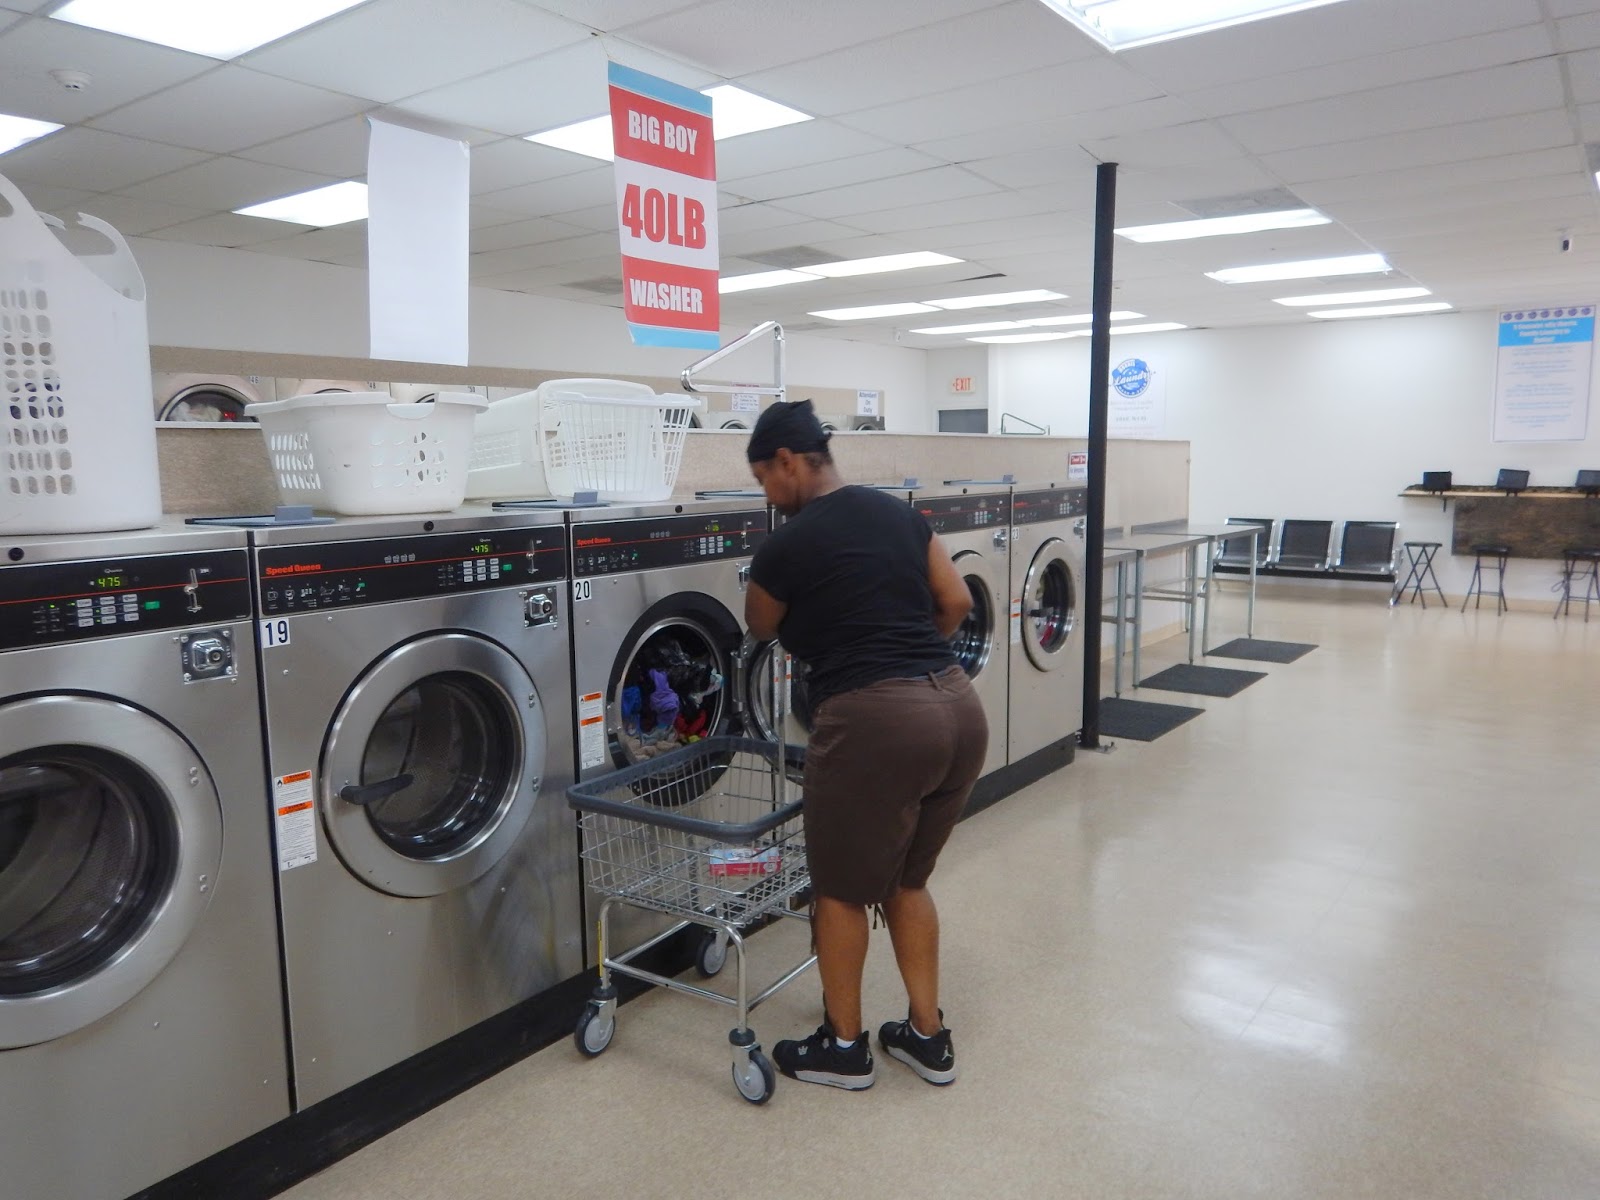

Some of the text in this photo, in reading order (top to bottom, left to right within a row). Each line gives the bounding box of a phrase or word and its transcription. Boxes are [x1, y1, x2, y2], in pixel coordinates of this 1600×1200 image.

[628, 109, 698, 155] BIG BOY
[622, 183, 707, 249] 40LB
[629, 278, 703, 314] WASHER
[955, 378, 971, 390] EXIT
[475, 544, 489, 553] 475
[266, 563, 321, 575] Speed Queen
[98, 577, 121, 587] 475
[575, 580, 590, 600] 20
[265, 620, 288, 646] 19
